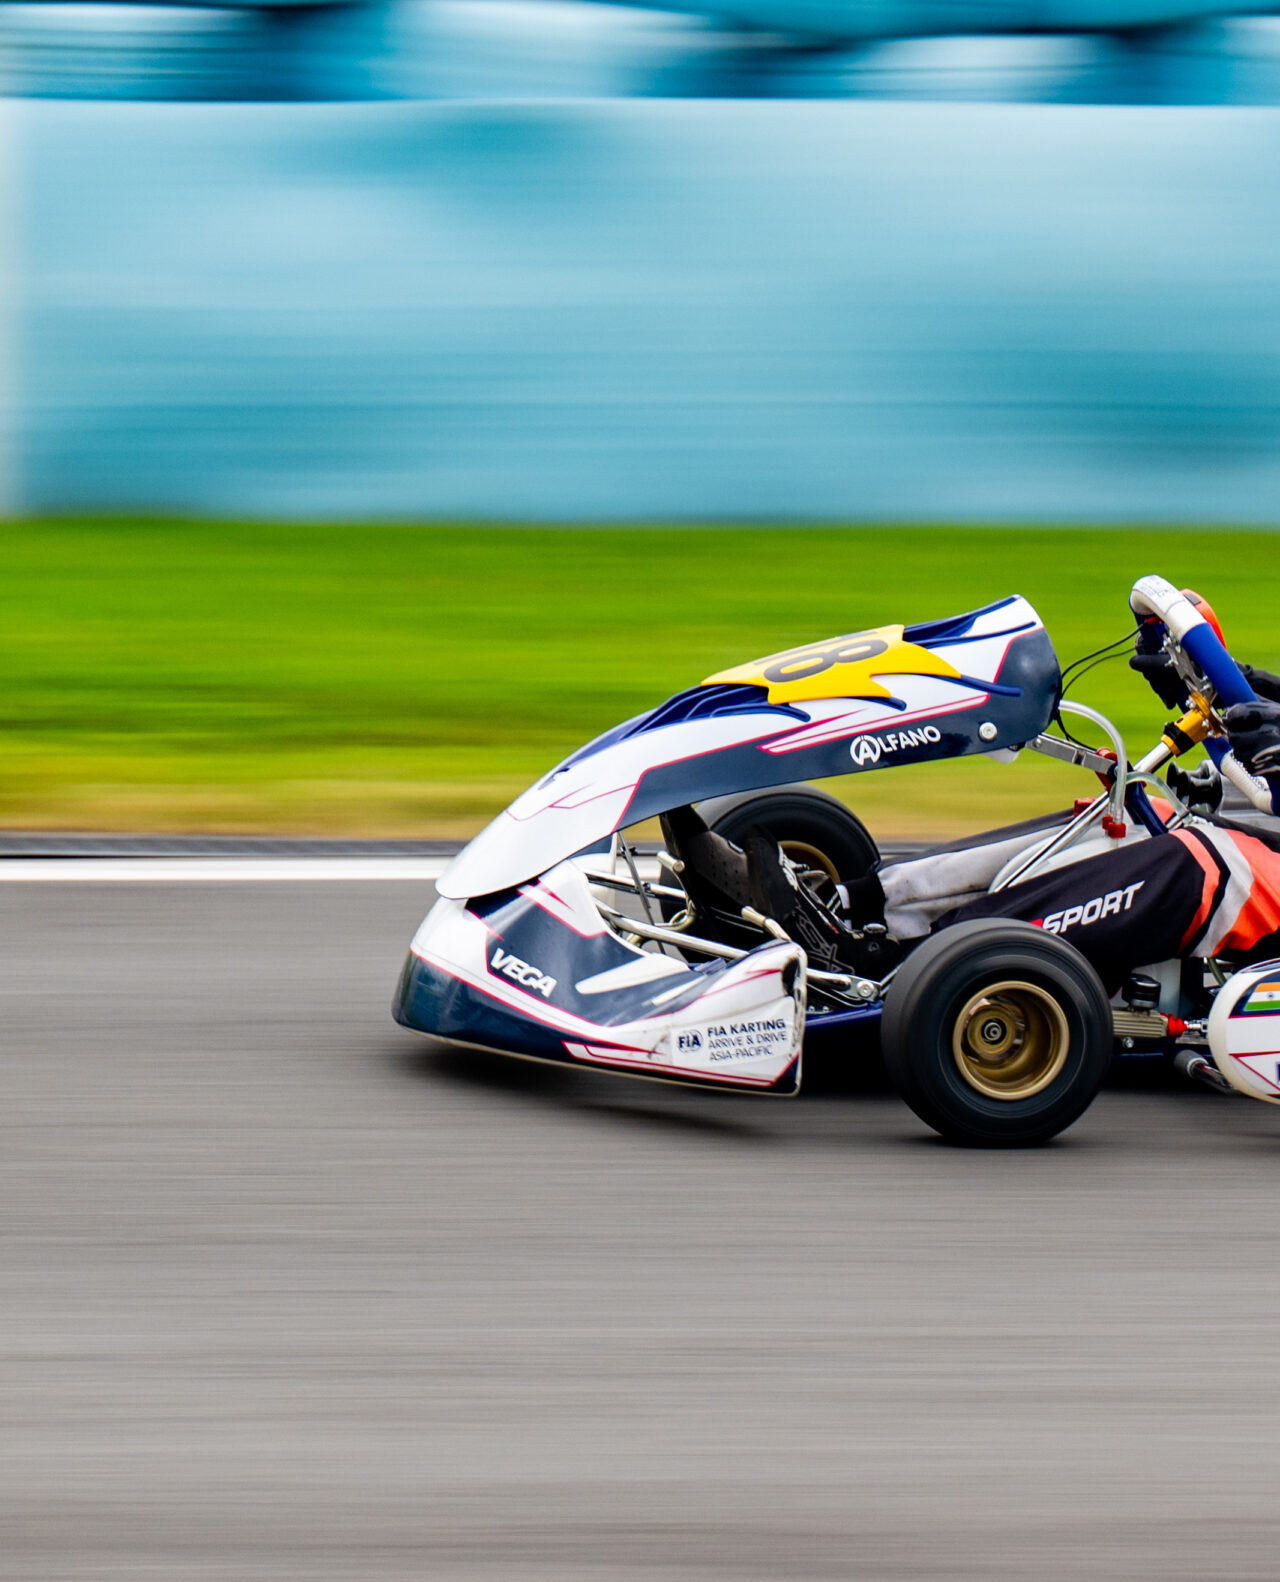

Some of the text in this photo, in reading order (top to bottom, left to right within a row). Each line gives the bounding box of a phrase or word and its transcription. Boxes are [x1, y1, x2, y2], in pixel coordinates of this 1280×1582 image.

[850, 725, 941, 766] ALFANO
[490, 947, 558, 998] VEGA
[707, 1018, 786, 1037] FIA KARTING
[678, 1035, 702, 1048] FIA
[708, 1031, 788, 1048] ARRIVE & DRIVE
[709, 1045, 774, 1061] ASIA-PACIFIC
